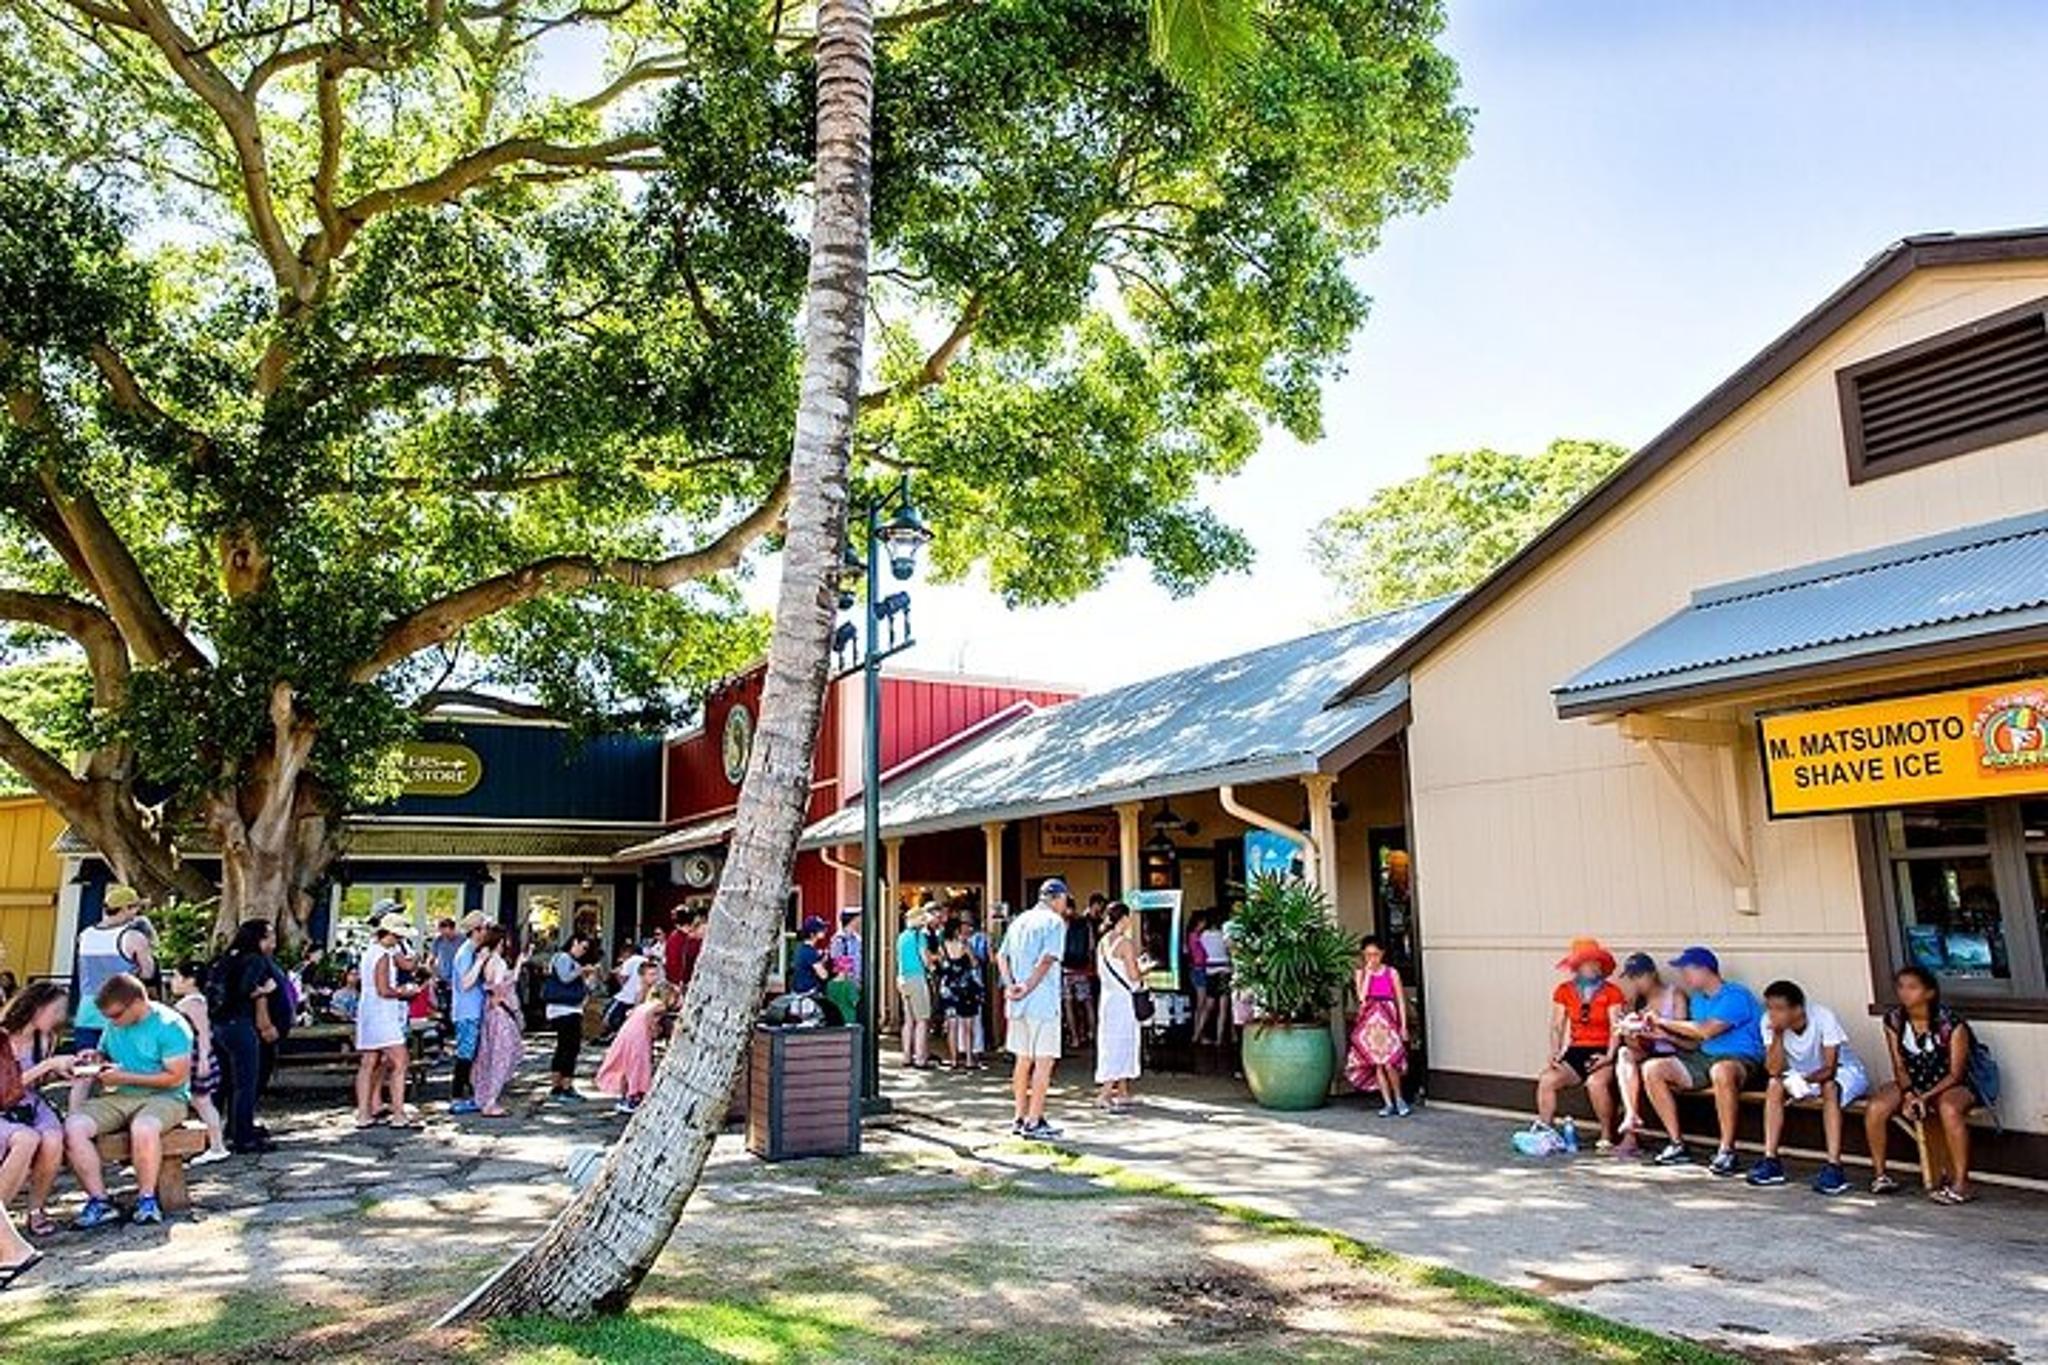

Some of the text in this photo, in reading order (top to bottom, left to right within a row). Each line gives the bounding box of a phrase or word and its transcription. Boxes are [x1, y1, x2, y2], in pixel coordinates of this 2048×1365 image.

[1769, 716, 1964, 760] M. MATSUMOTO
[411, 770, 468, 783] STORE
[1794, 751, 1943, 788] SHAVE ICE
